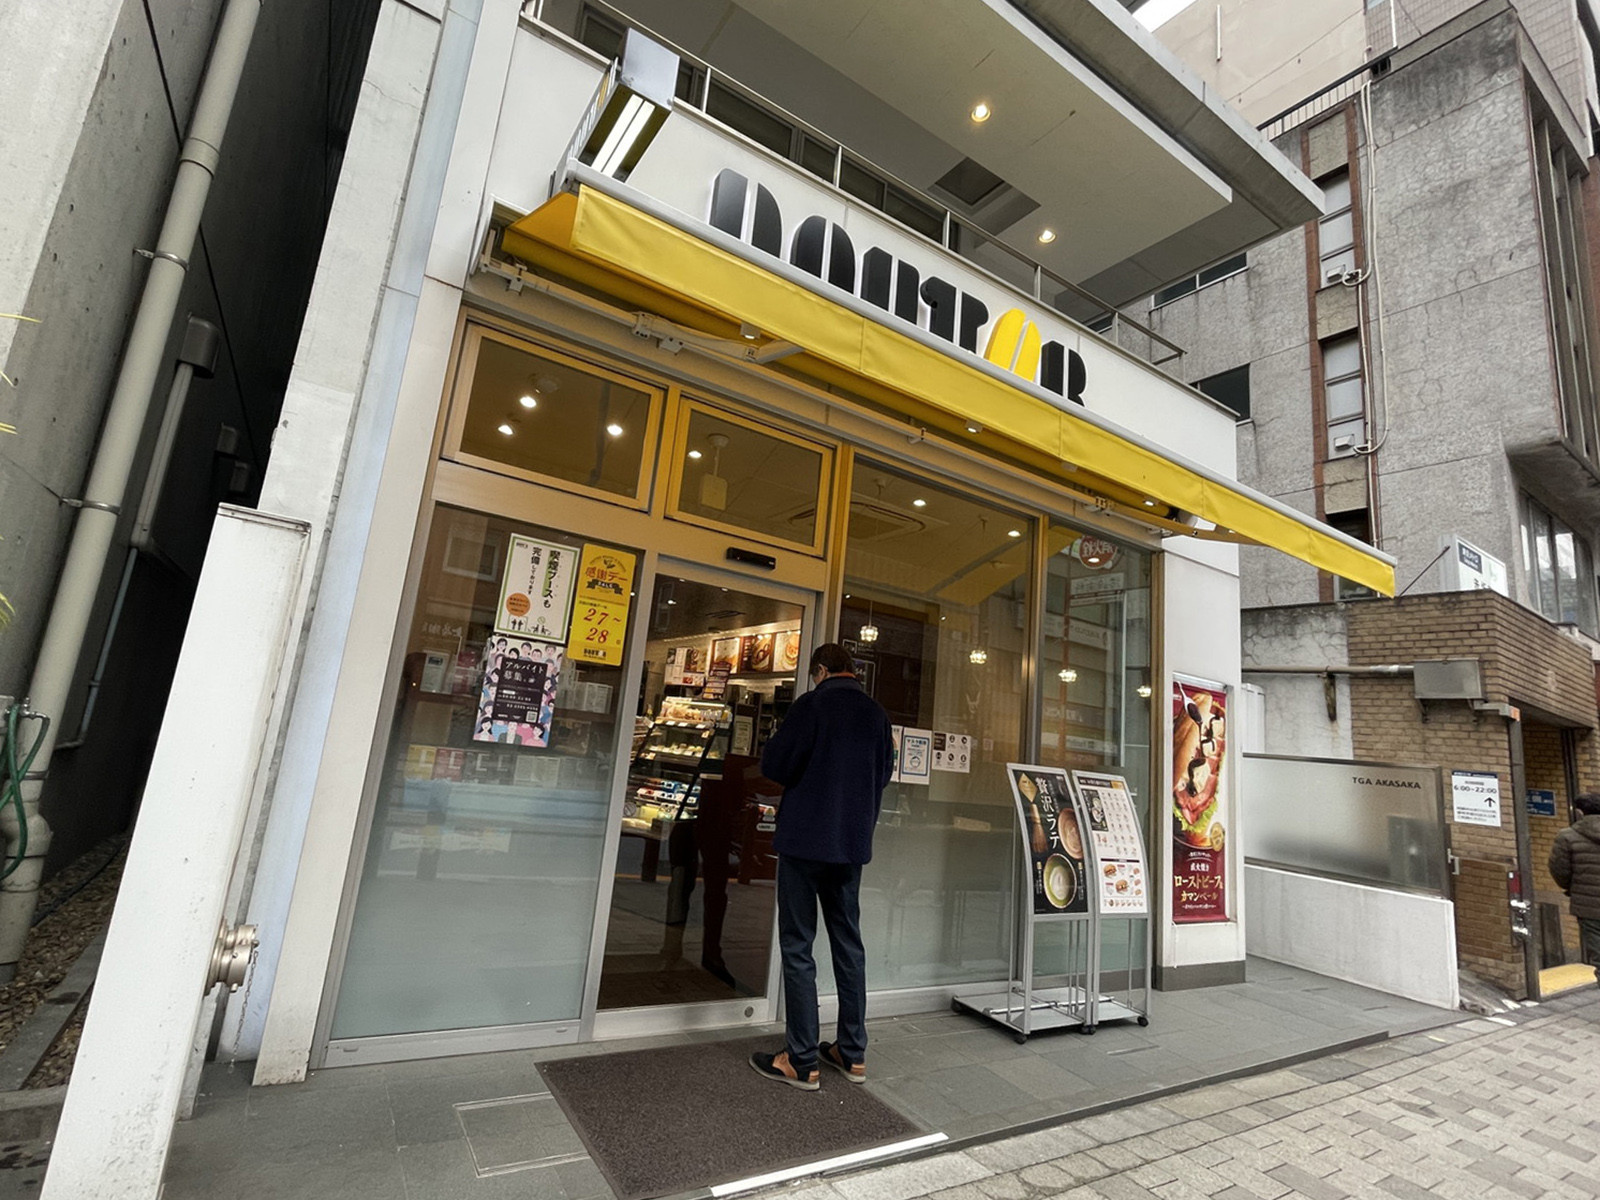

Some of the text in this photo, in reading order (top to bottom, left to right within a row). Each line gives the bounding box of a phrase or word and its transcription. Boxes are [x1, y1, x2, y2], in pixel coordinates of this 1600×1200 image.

[543, 550, 561, 608] 喫煙ブースも
[585, 566, 628, 582] 感謝デー
[585, 627, 609, 644] 28
[505, 661, 544, 674] アルバイト
[1352, 777, 1421, 789] TGA AKASAKA
[1035, 777, 1060, 849] 贅沢ラテ
[1180, 890, 1218, 903] カマンベール
